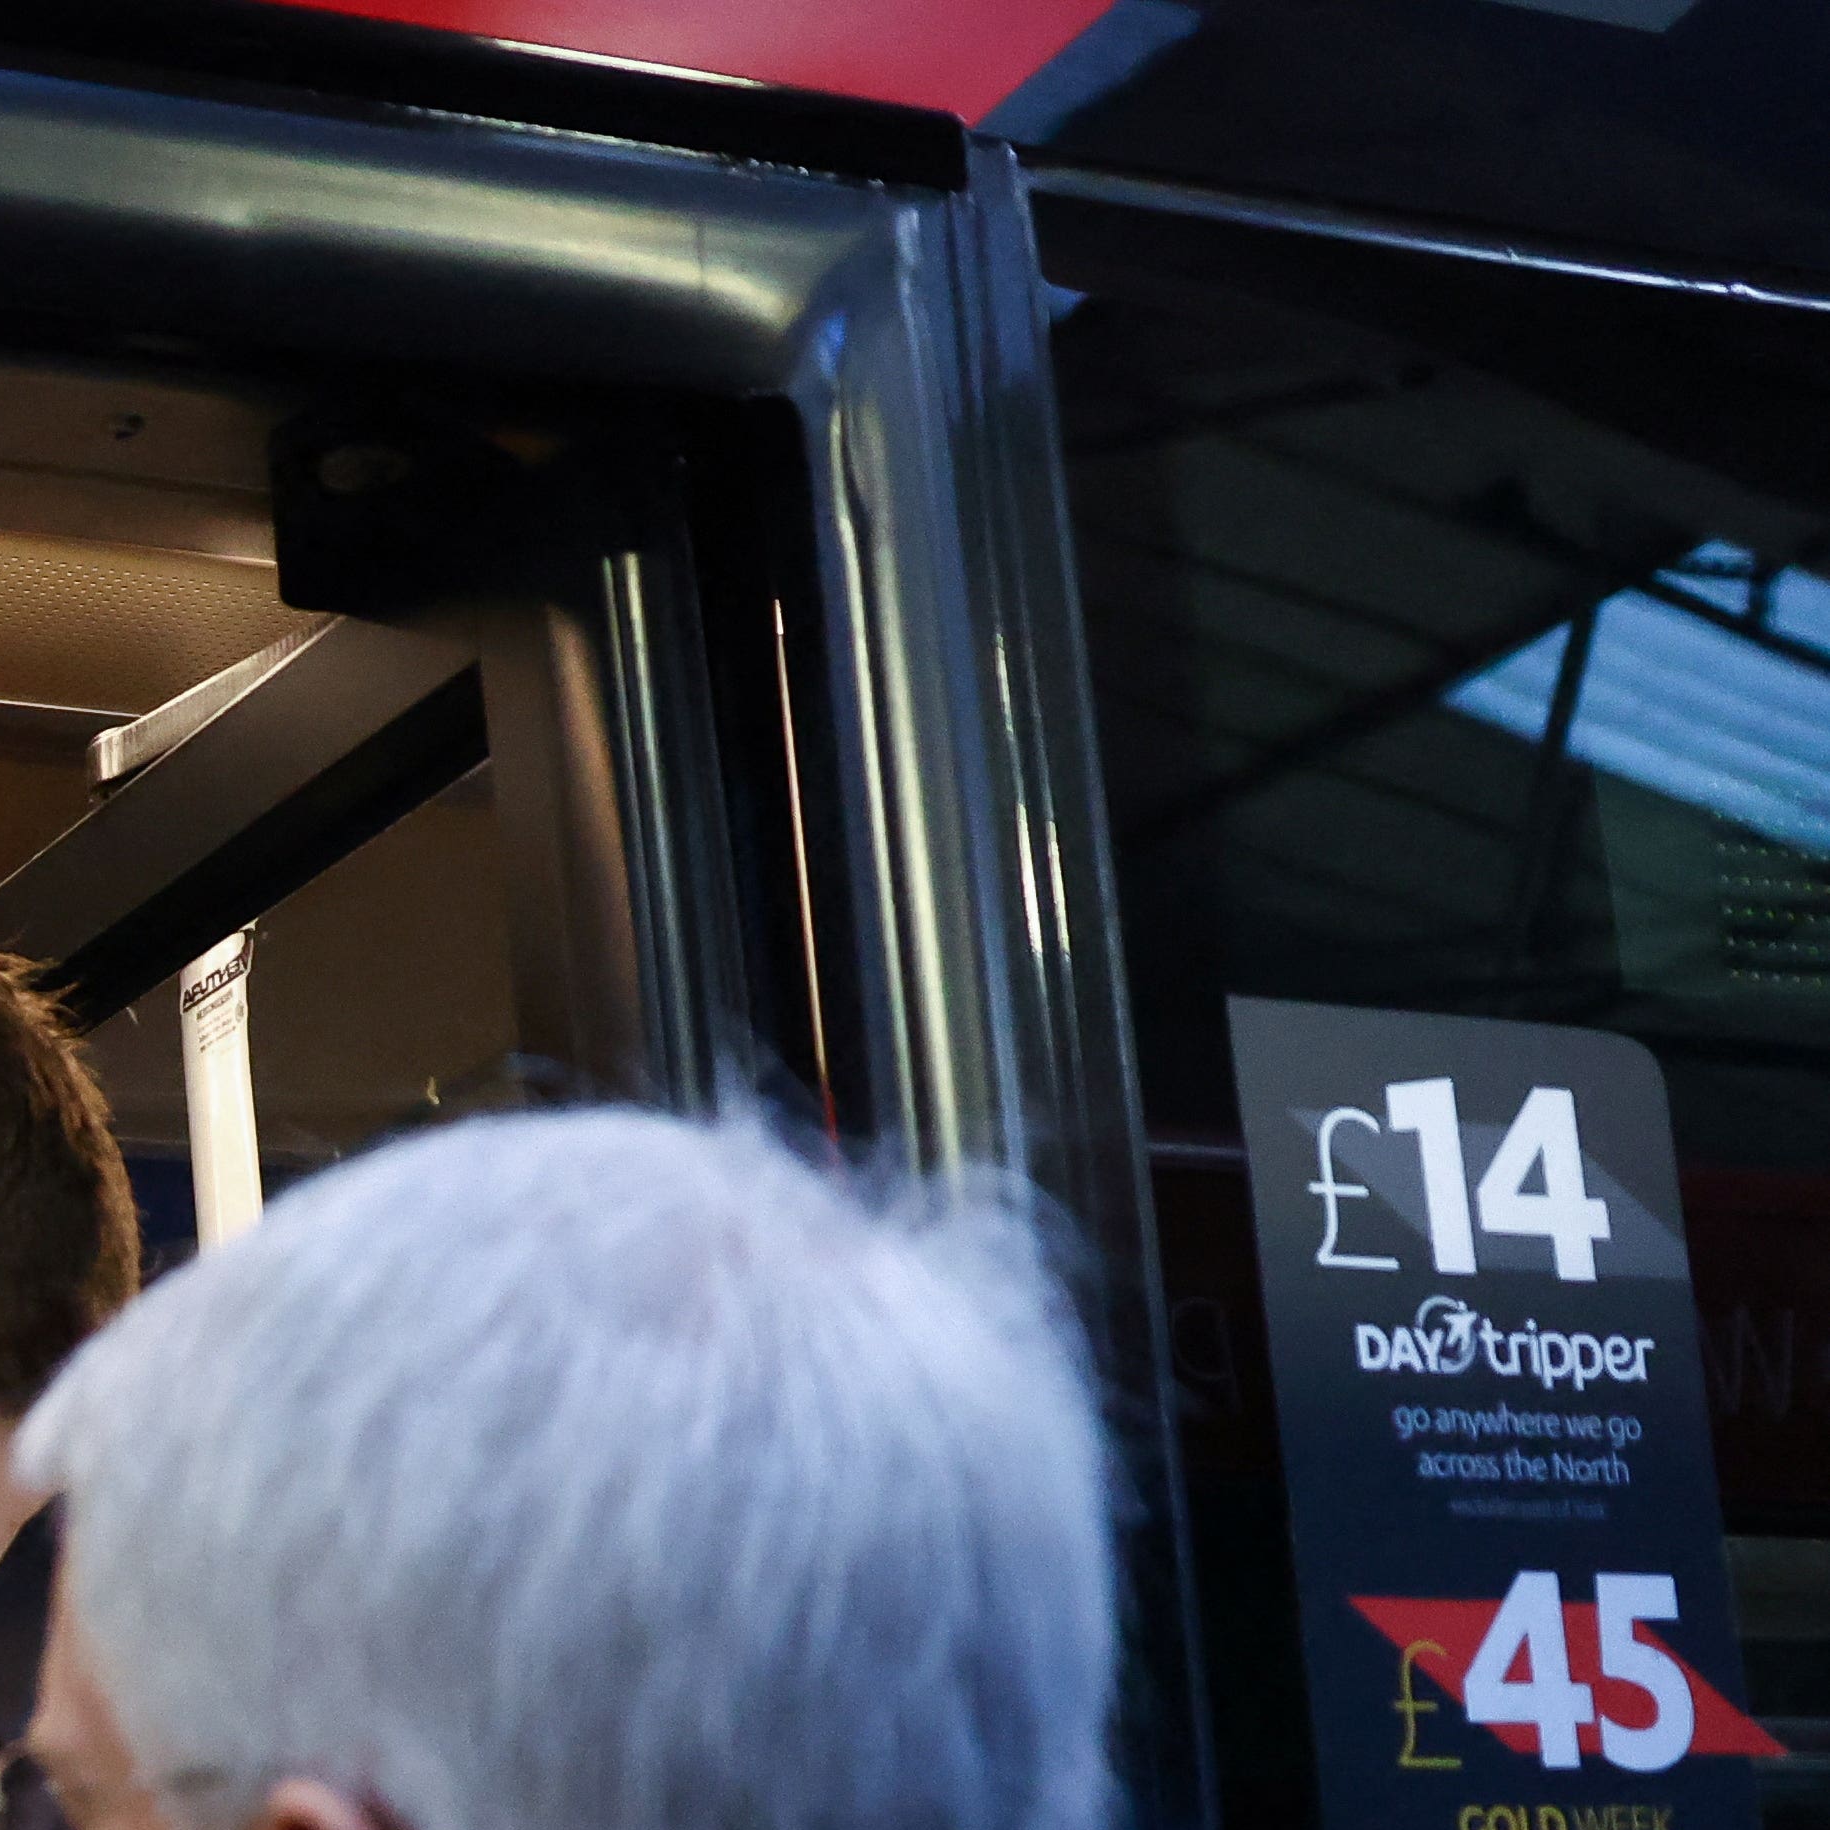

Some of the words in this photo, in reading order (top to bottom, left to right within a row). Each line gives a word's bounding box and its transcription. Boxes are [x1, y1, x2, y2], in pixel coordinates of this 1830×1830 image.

[1307, 1077, 1611, 1282] £14
[1354, 1322, 1443, 1374] DAY
[1479, 1316, 1656, 1391] tripper
[1392, 1404, 1432, 1441] go
[1434, 1402, 1561, 1442] anywhere
[1564, 1414, 1603, 1440] we
[1606, 1415, 1642, 1449] go
[1418, 1450, 1502, 1480] across
[1503, 1448, 1548, 1482] the
[1551, 1449, 1631, 1485] North
[1394, 1569, 1695, 1774] £45
